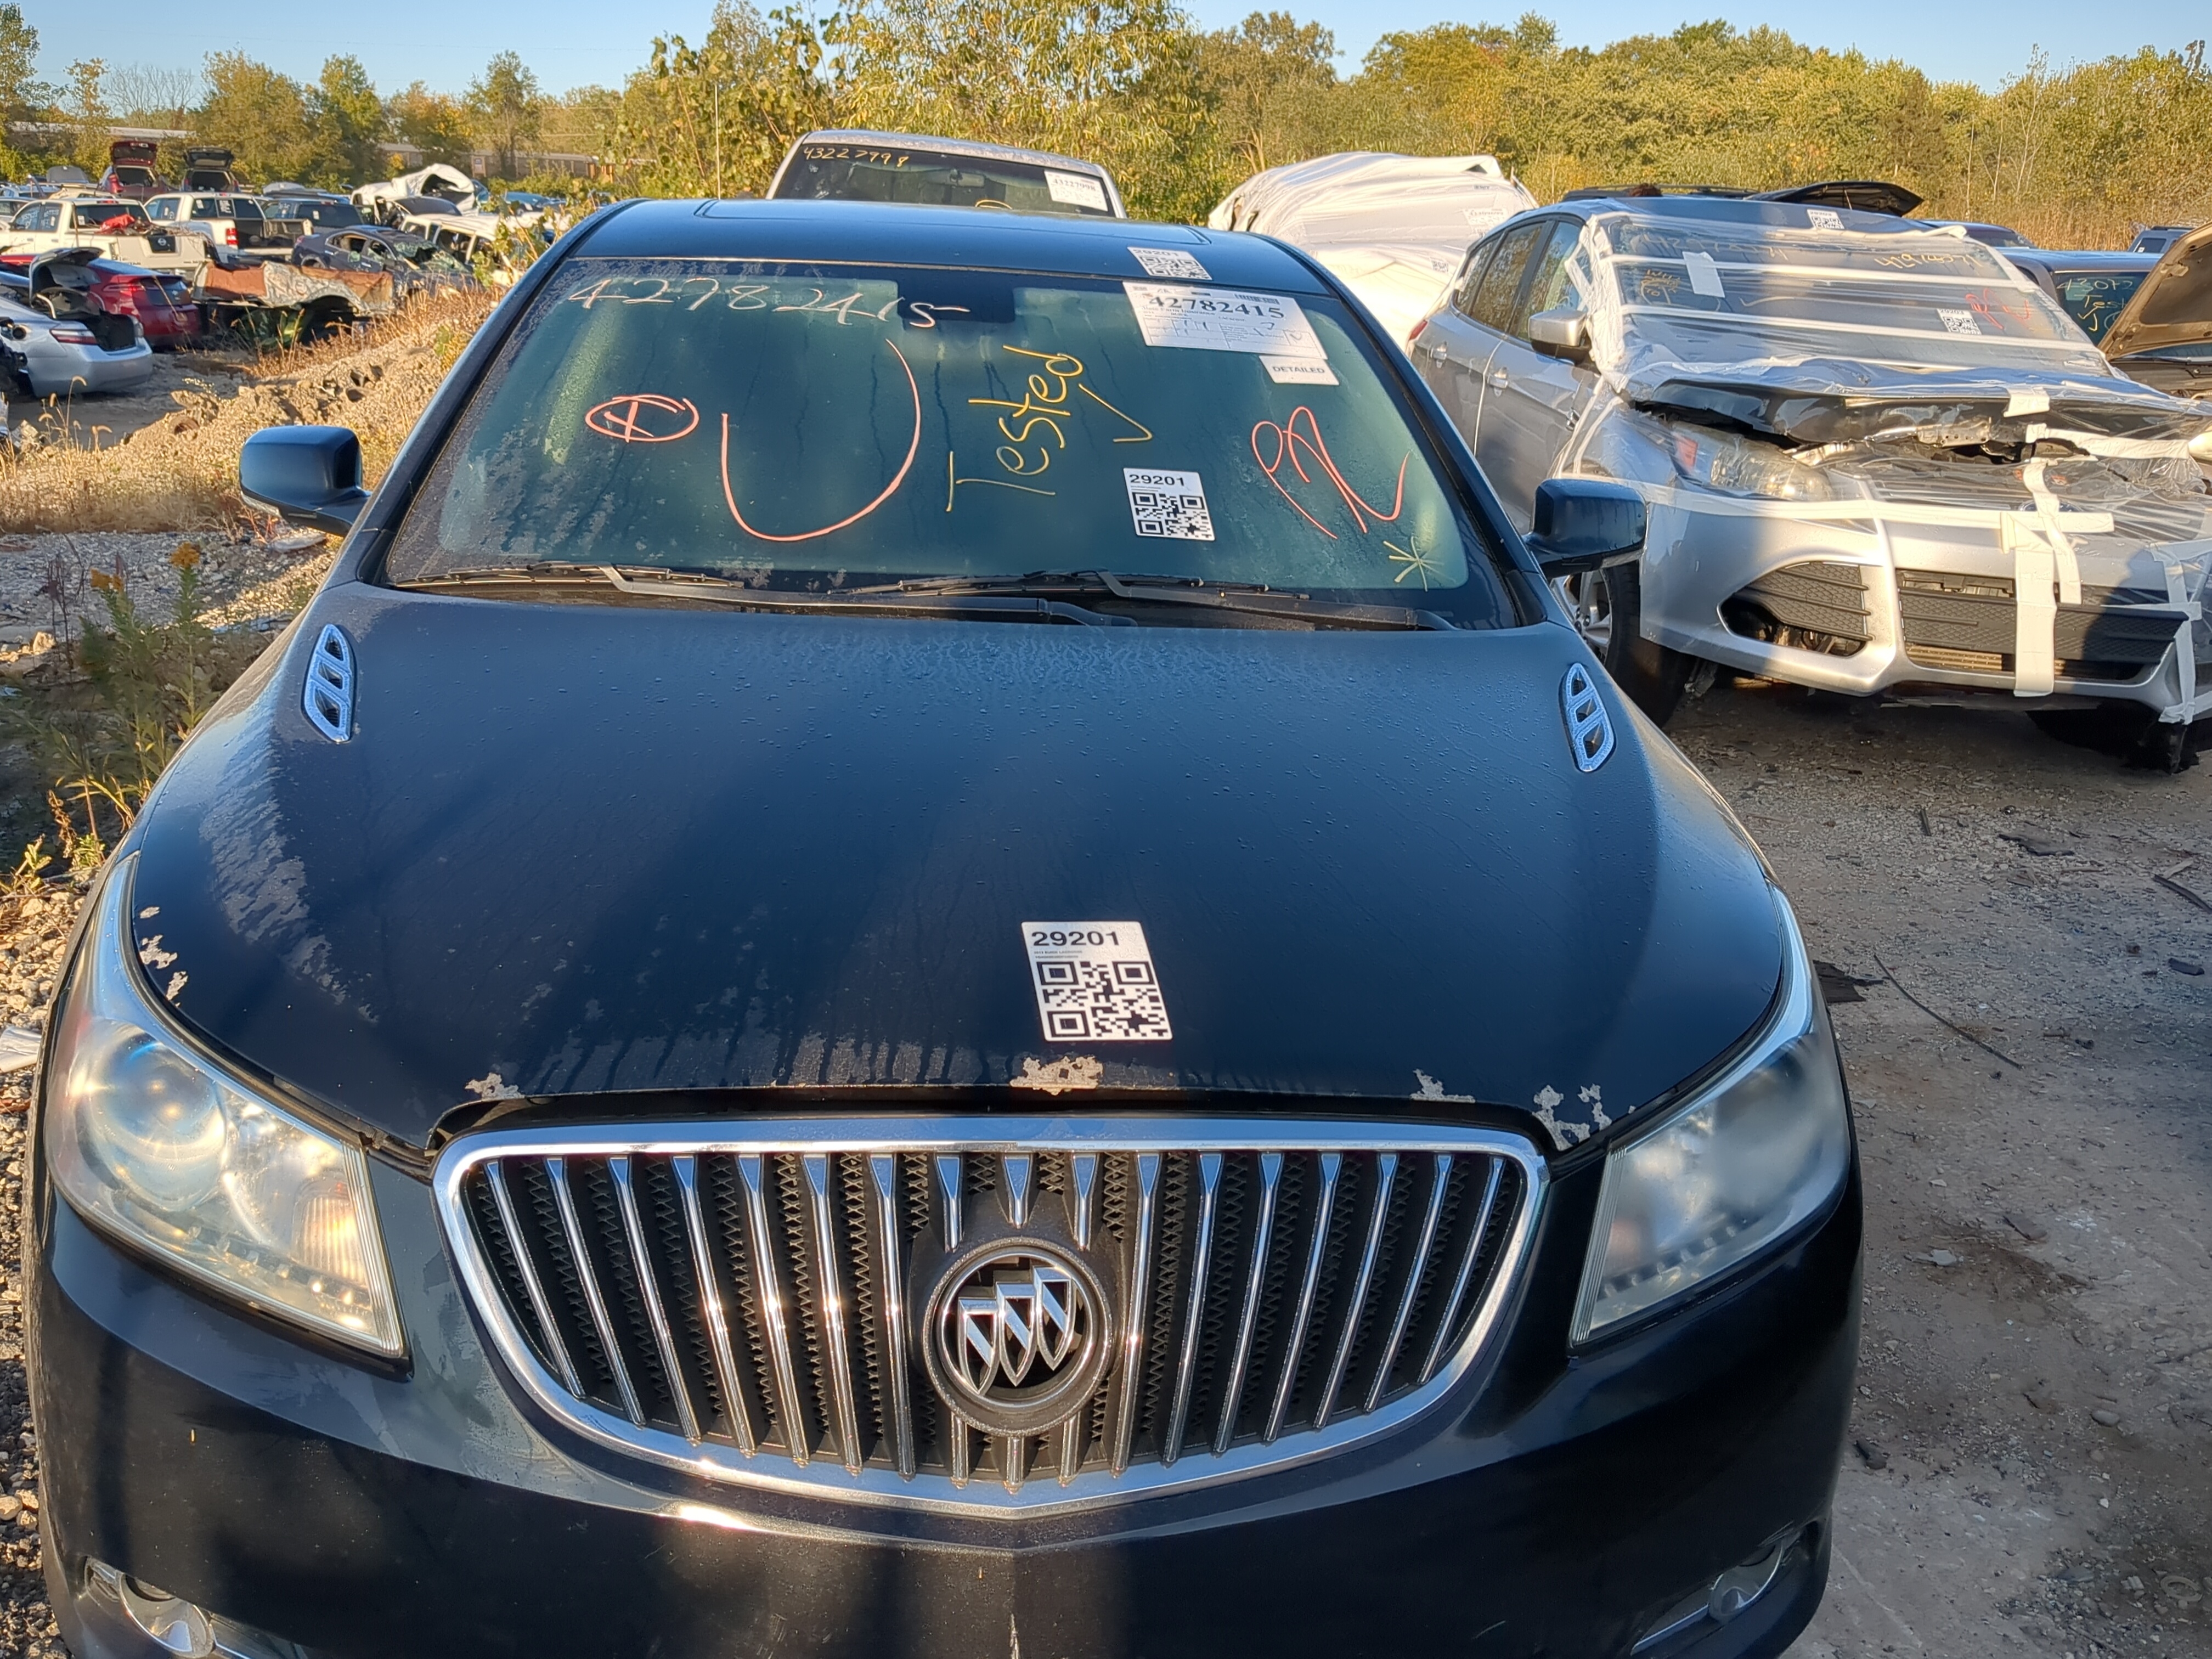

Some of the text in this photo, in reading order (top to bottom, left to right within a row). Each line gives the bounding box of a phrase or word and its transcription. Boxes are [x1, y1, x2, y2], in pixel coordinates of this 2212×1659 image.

[568, 277, 970, 329] 42782415
[1149, 296, 1285, 319] 42782415
[1272, 365, 1325, 374] DETAILED
[946, 344, 1084, 512] Tested
[1128, 473, 1185, 487] 29201
[1031, 930, 1120, 946] 29201
